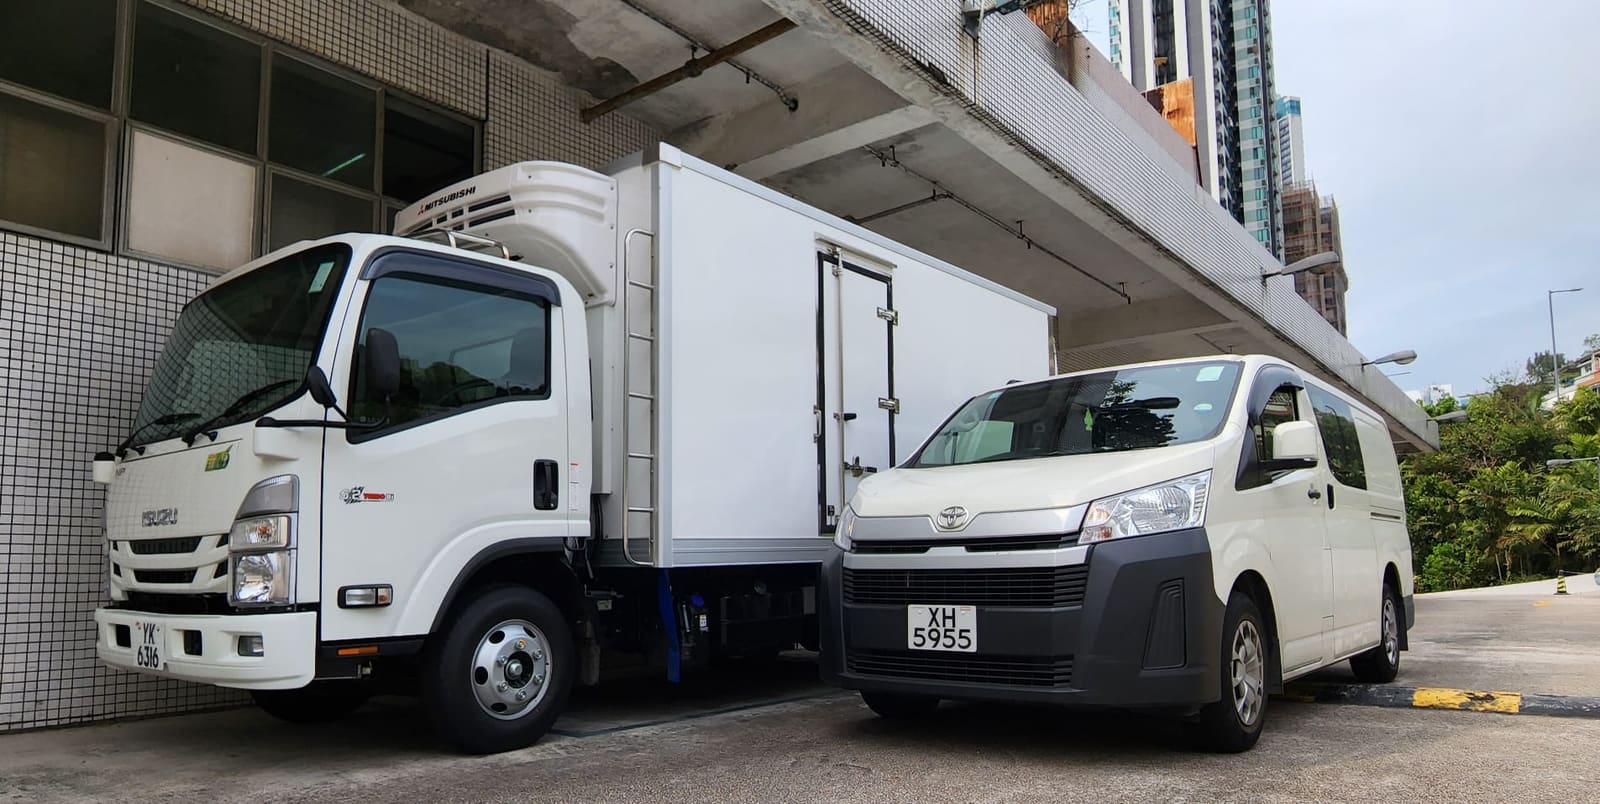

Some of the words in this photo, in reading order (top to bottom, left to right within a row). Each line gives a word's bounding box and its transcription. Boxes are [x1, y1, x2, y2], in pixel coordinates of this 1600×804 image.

[424, 186, 476, 212] MITSUBISHI
[141, 507, 178, 528] ISUZU
[928, 607, 956, 628] XH
[143, 622, 156, 645] YK
[913, 627, 971, 649] 5955
[137, 645, 159, 668] 6316
